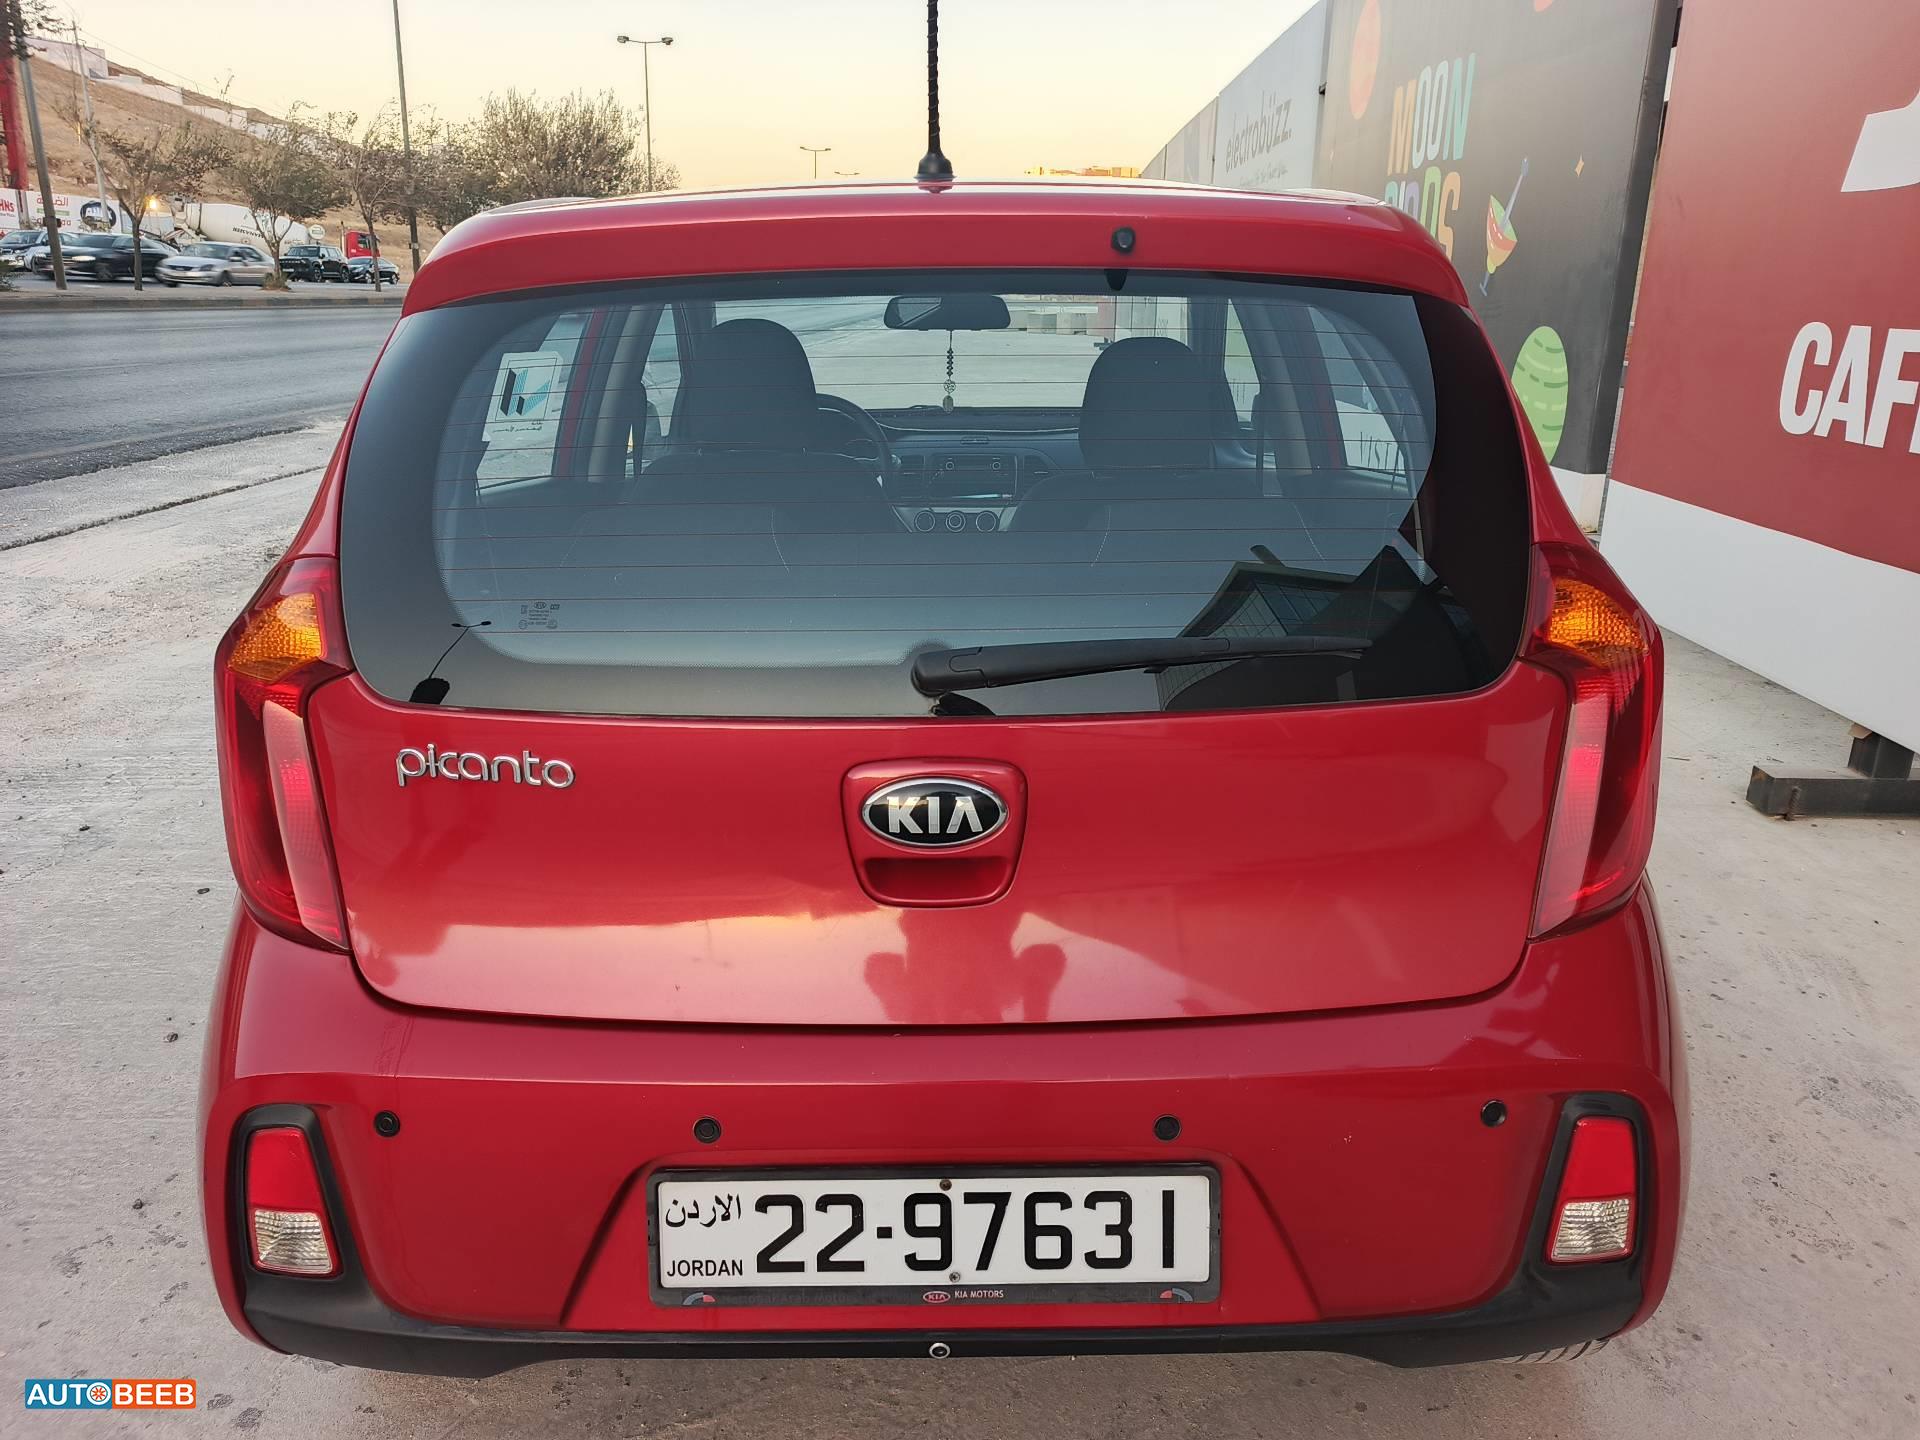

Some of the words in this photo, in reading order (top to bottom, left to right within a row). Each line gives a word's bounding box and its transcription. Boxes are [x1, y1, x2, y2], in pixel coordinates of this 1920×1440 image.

[1387, 52, 1477, 176] MOON
[395, 743, 575, 788] picanto
[886, 796, 983, 834] KIA
[665, 1193, 742, 1228] الاردن
[755, 1190, 1174, 1273] 22-97631
[666, 1259, 743, 1277] JORDAN
[954, 1290, 968, 1299] KIA
[970, 1289, 1004, 1298] MOTORS
